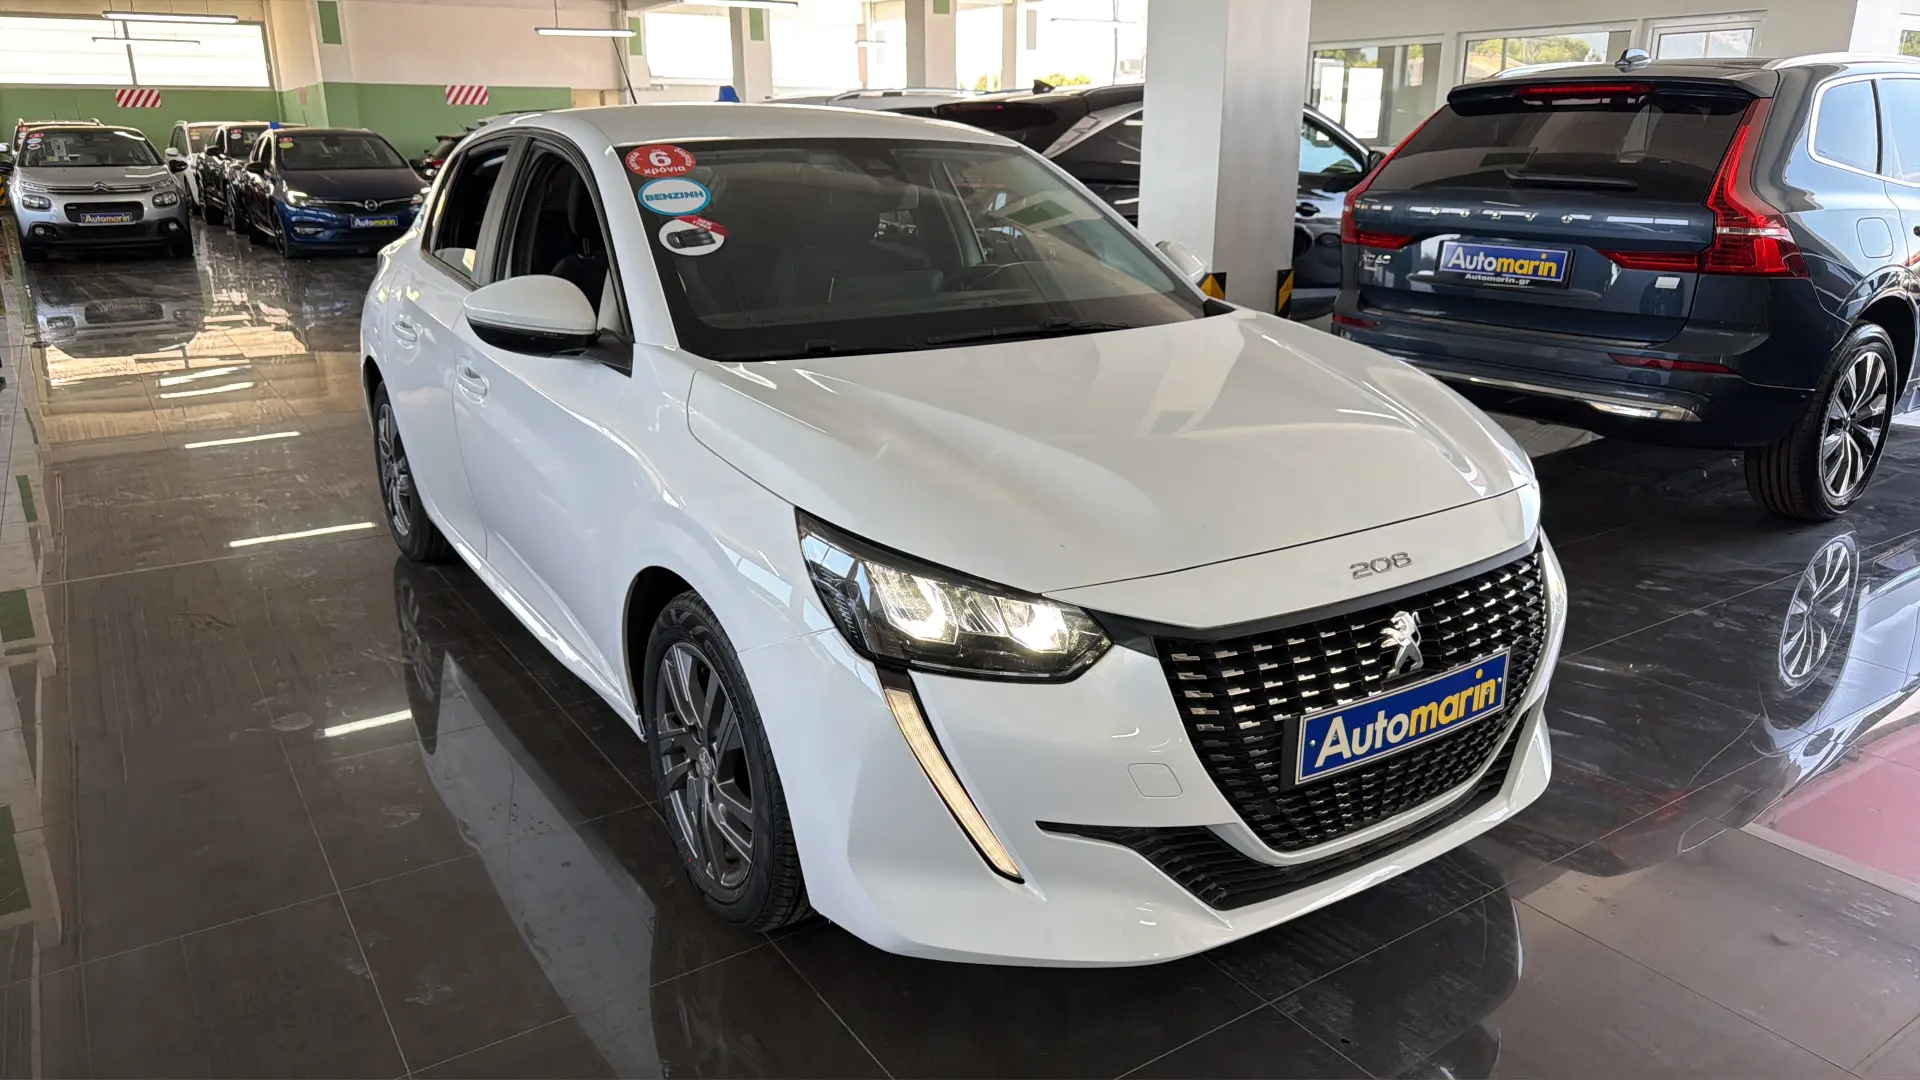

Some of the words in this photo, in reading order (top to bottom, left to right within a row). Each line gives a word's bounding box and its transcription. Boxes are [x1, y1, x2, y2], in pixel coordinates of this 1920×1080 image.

[649, 151, 672, 167] 6
[644, 165, 687, 175] χρόνια
[85, 213, 130, 223] Automarin
[1447, 246, 1558, 277] Automarin
[1464, 273, 1531, 286] Automarin.gr
[1349, 551, 1413, 580] 208
[1314, 668, 1497, 768] Automarin
